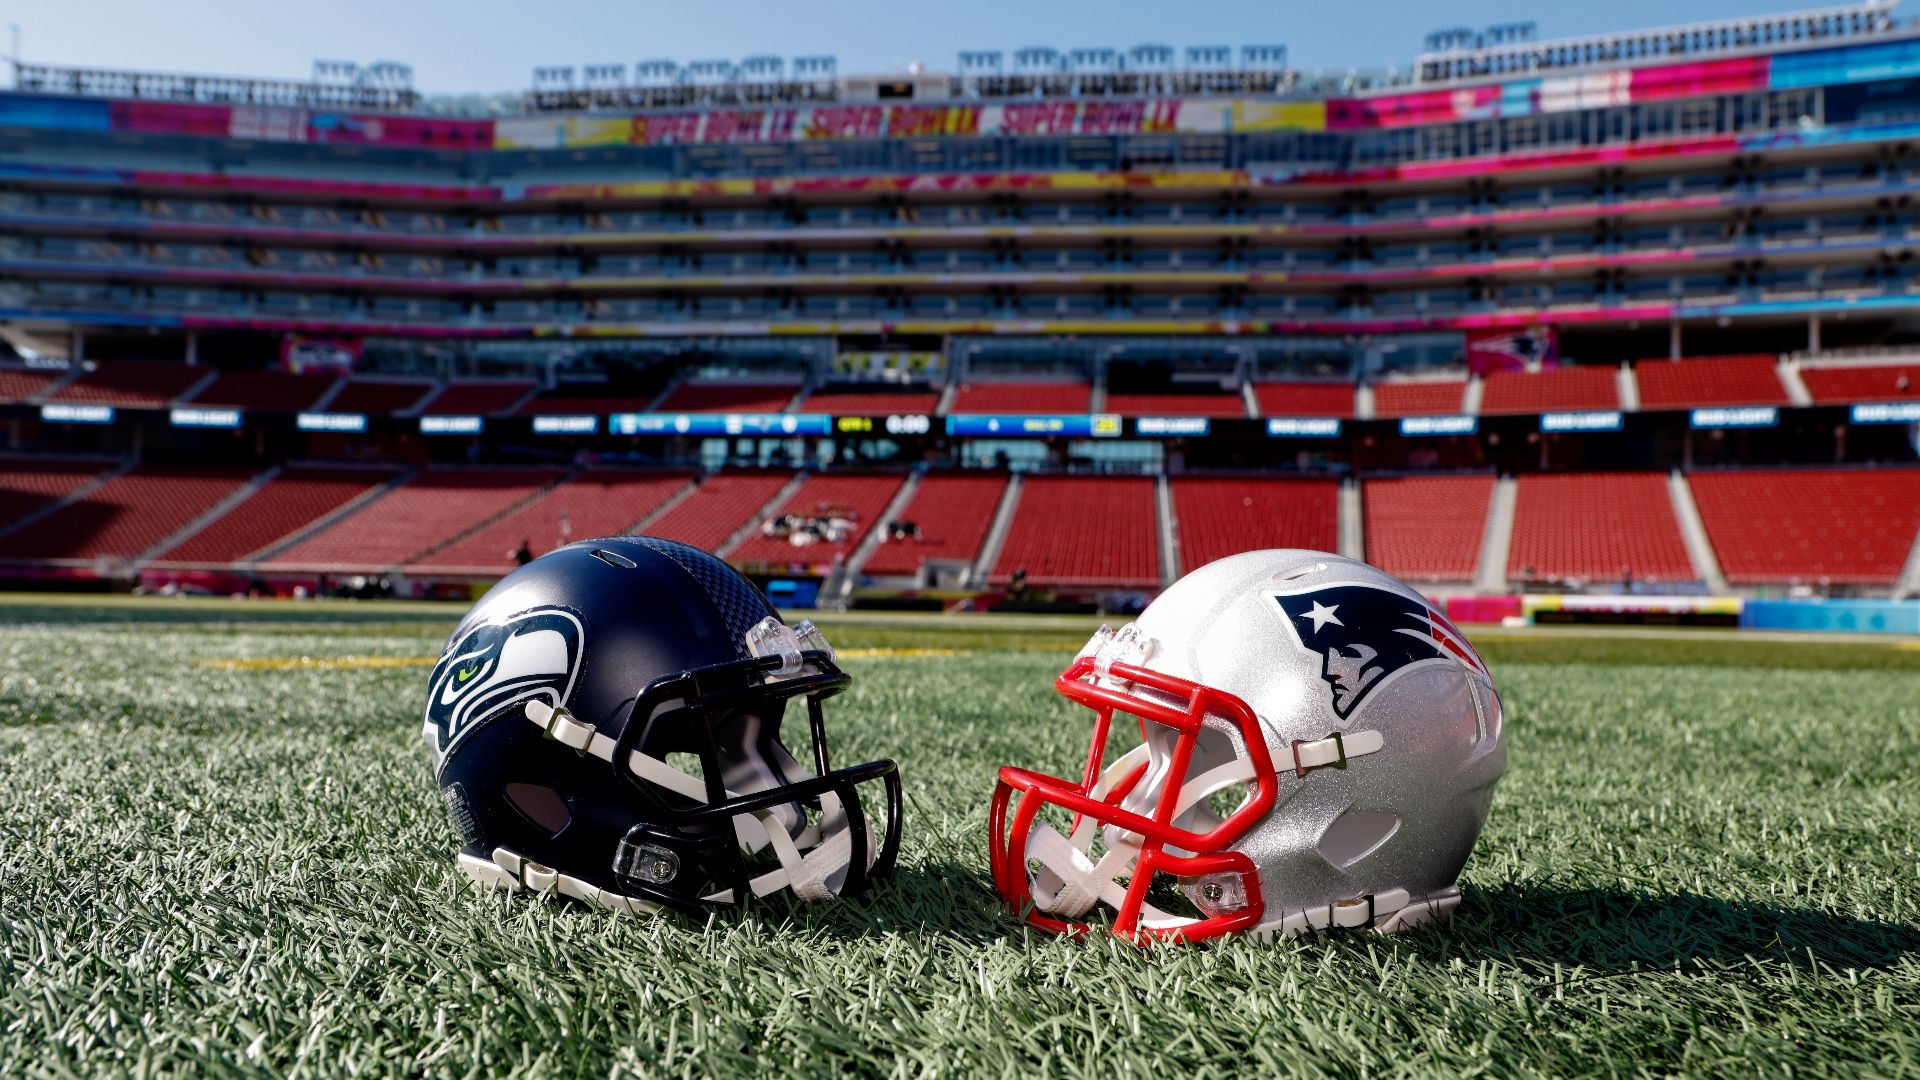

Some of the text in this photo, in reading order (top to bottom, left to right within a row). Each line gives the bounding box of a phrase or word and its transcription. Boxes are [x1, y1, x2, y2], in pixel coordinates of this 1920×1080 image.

[629, 112, 700, 144] SUPER
[703, 110, 766, 143] BOWL
[808, 106, 884, 139] SUPER
[887, 105, 949, 137] BOWL
[1000, 101, 1076, 135] SUPER
[1080, 101, 1148, 134] BOWL
